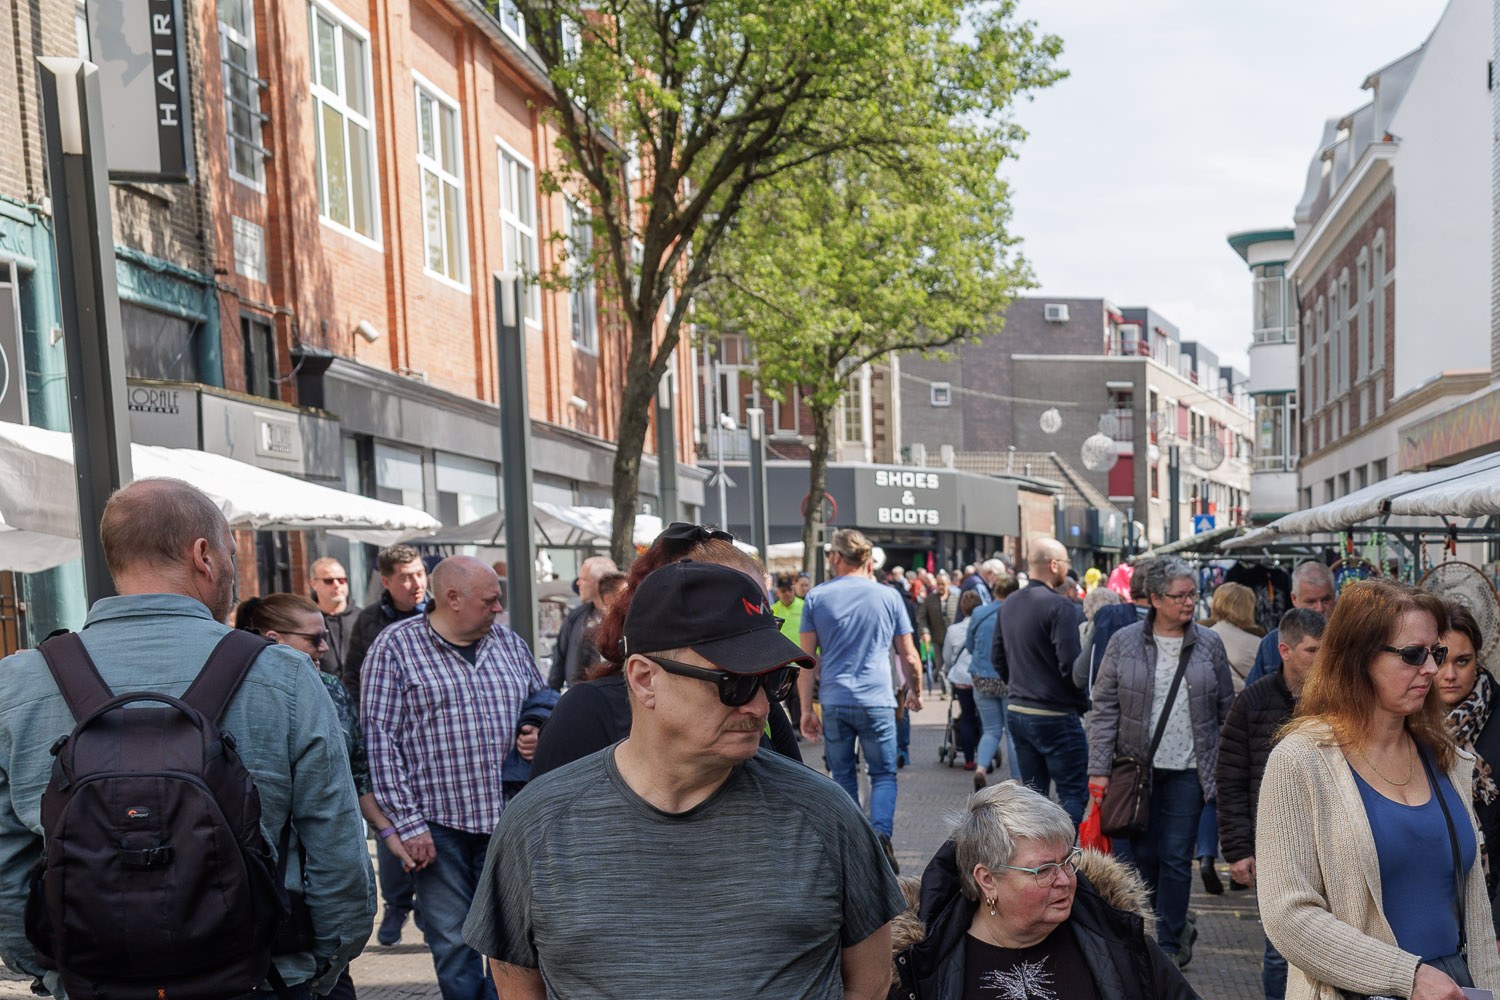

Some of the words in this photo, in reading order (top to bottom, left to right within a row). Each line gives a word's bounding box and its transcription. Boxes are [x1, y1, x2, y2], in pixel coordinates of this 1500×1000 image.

[153, 0, 178, 126] HAIR
[128, 388, 179, 408] LORALE
[875, 470, 939, 489] SHOES
[901, 490, 916, 506] &
[878, 507, 940, 525] BOOTS
